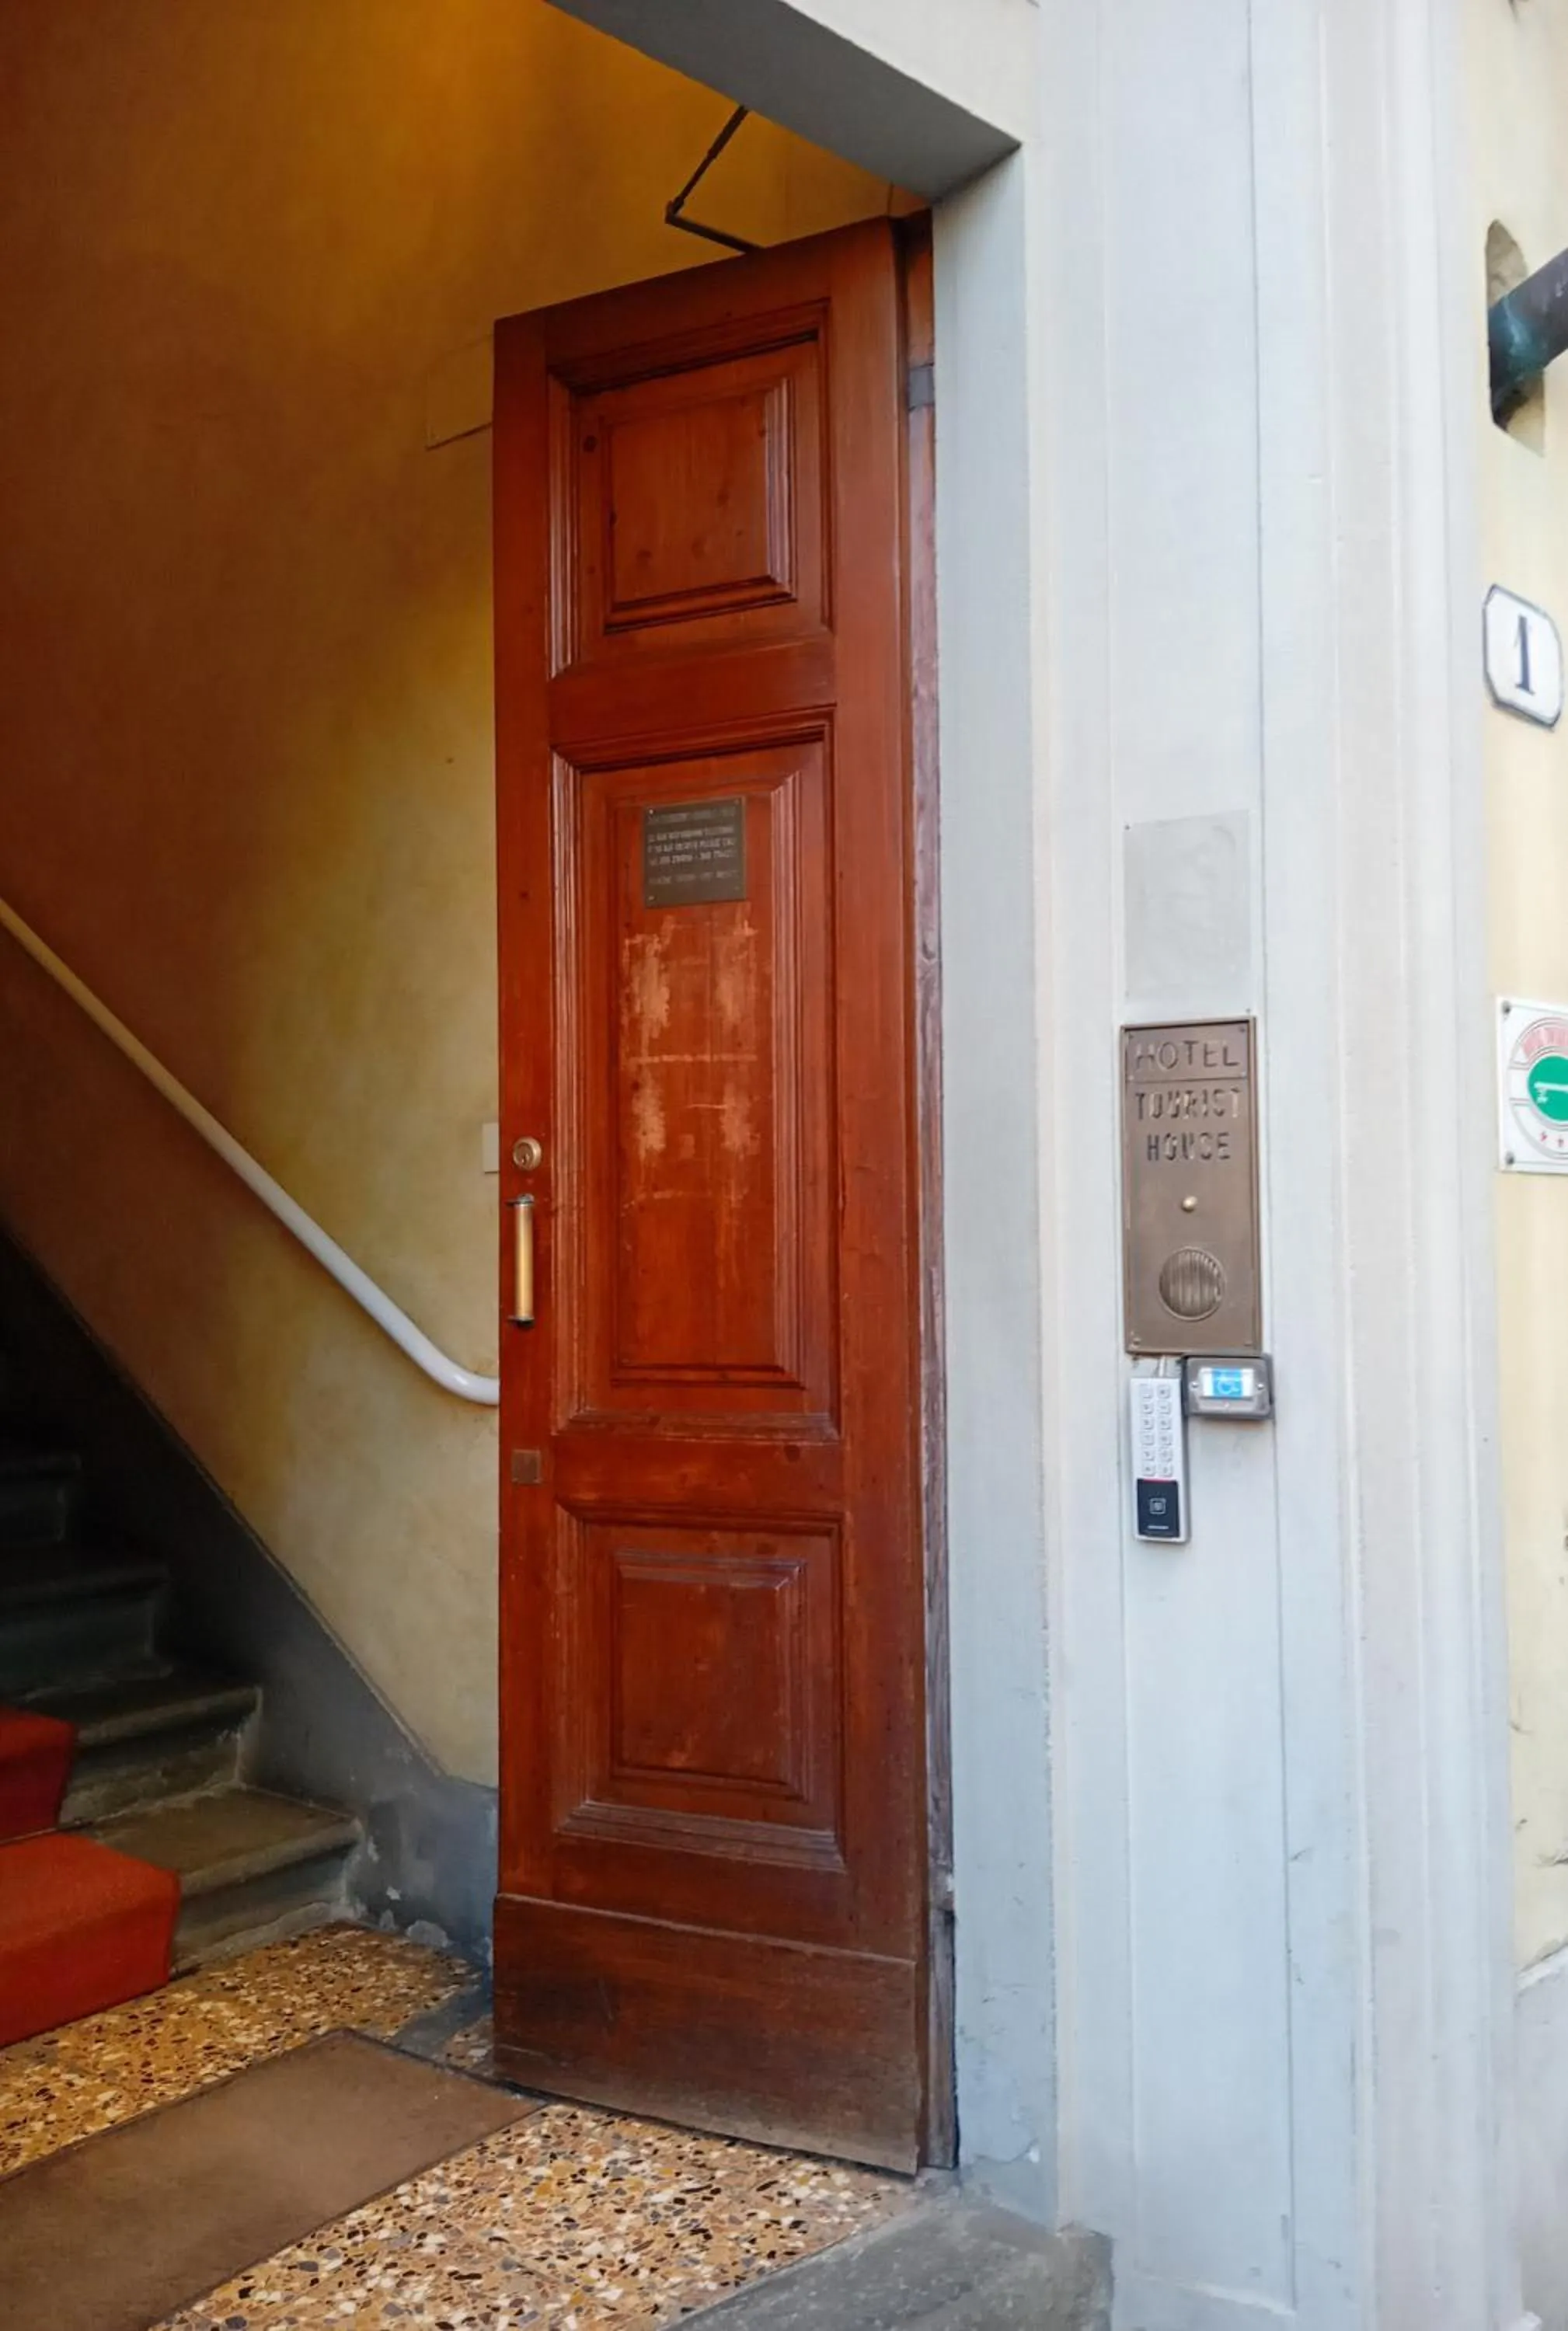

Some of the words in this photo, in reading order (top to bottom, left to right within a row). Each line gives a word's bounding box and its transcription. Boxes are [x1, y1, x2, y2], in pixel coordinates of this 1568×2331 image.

[1514, 614, 1535, 695] 1
[1136, 1040, 1239, 1071] HOTEL
[1135, 1088, 1242, 1120] TOURIST
[1146, 1131, 1231, 1161] HOUSE
